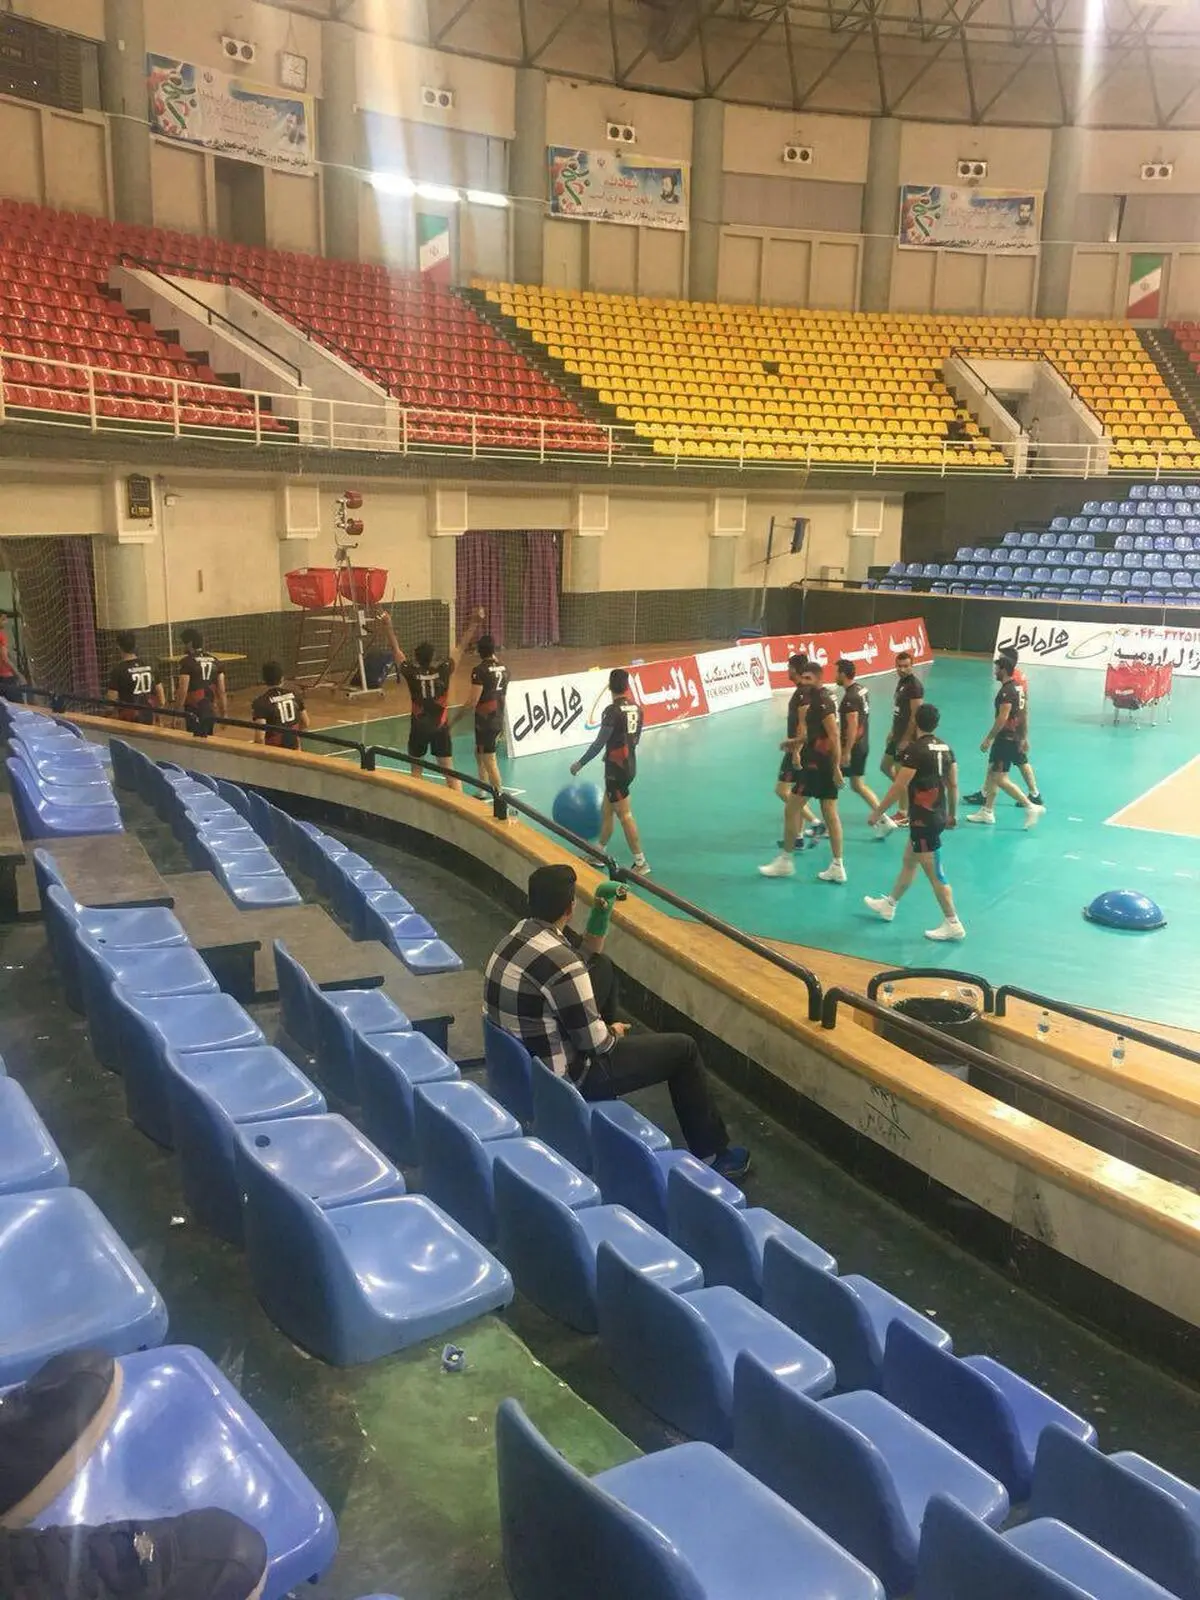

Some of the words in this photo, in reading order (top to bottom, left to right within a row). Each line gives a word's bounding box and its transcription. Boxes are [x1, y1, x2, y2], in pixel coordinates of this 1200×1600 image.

[200, 662, 212, 681] 17
[495, 671, 503, 691] 2
[132, 672, 152, 695] 20
[421, 679, 436, 699] 11
[277, 699, 297, 724] 10
